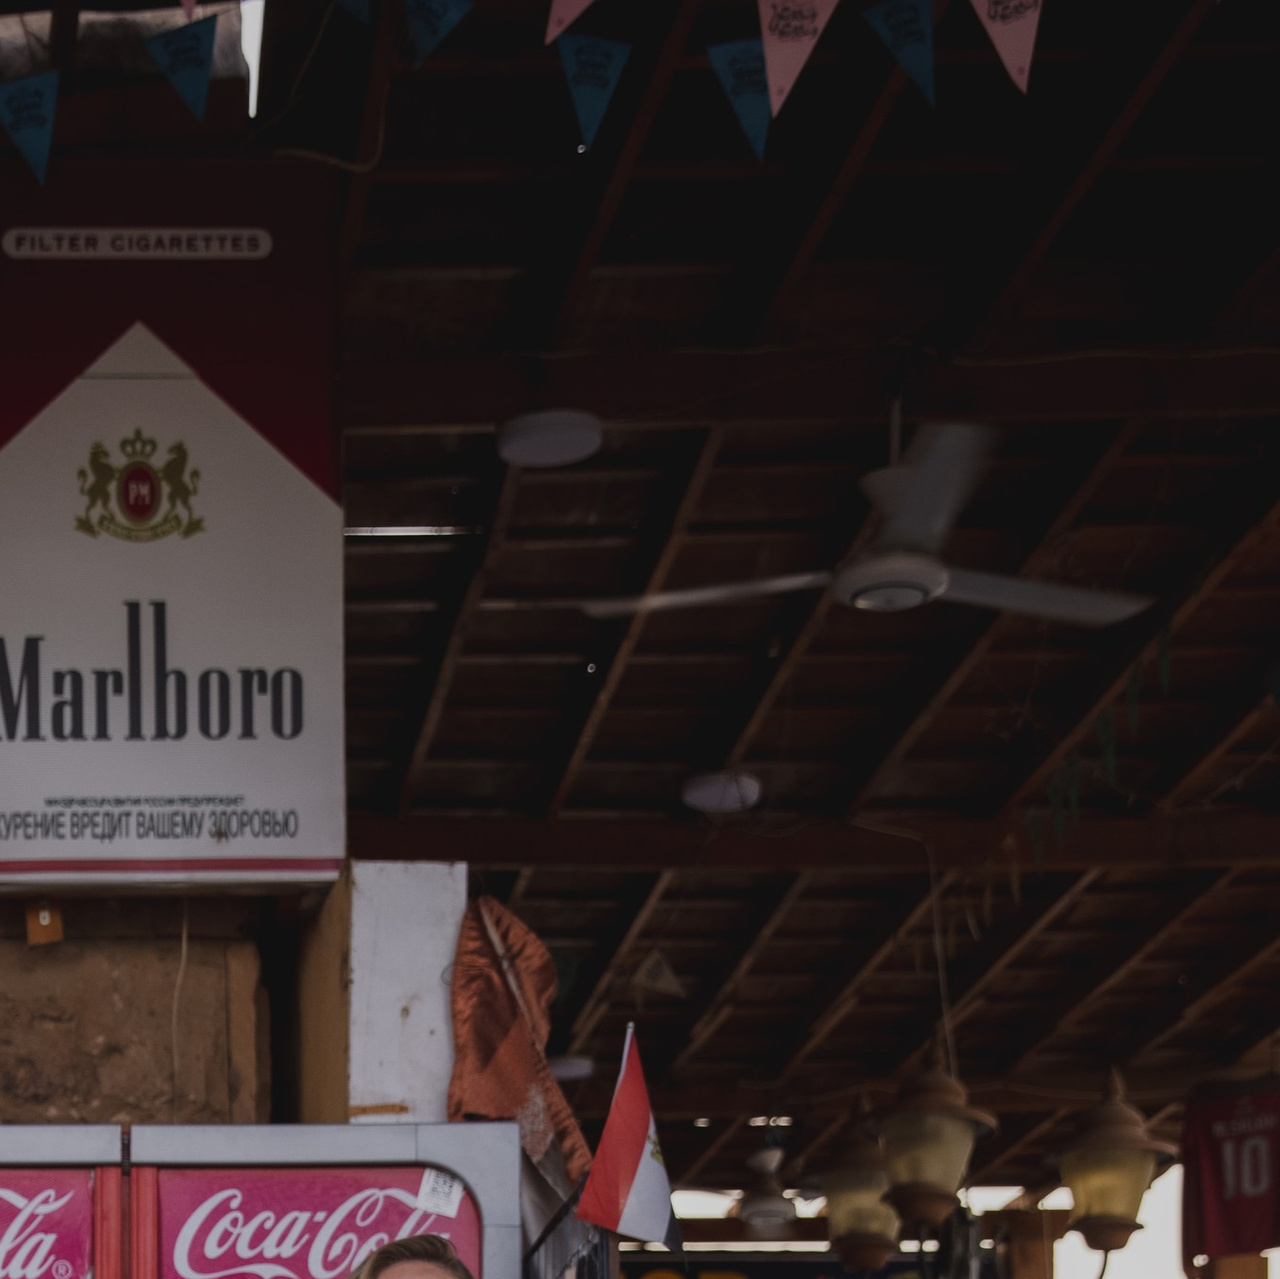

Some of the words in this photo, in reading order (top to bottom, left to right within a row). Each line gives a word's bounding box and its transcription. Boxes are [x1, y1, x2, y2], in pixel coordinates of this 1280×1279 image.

[14, 233, 99, 252] FILTER
[110, 233, 261, 252] CIGARETTES
[128, 481, 152, 506] PM
[70, 811, 133, 843] ВРЕДИТ
[136, 811, 205, 840] ВАШЕМУ
[207, 808, 299, 842] ЗДОРОВЬЮ
[1222, 1136, 1271, 1200] 10
